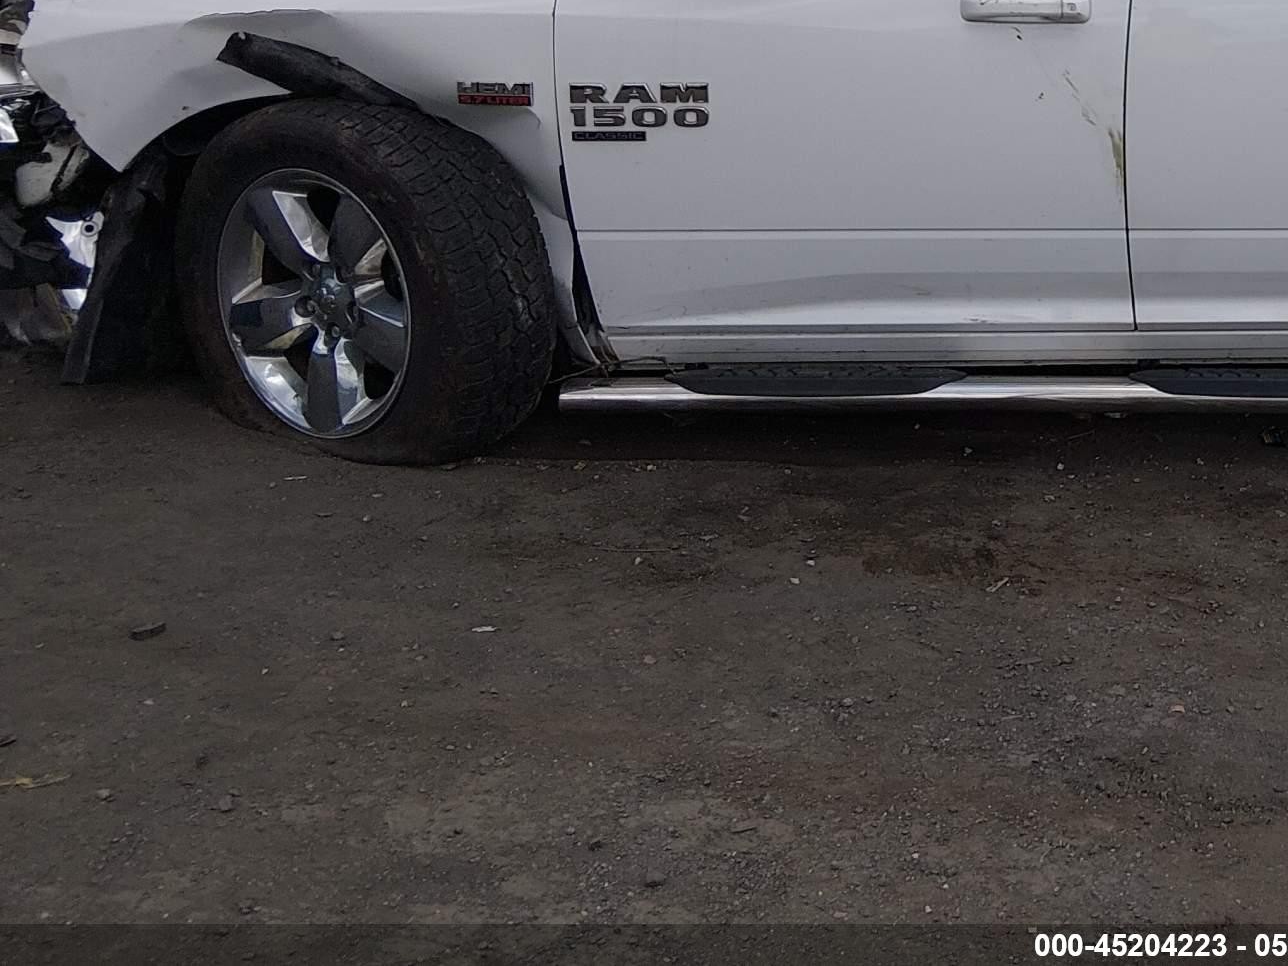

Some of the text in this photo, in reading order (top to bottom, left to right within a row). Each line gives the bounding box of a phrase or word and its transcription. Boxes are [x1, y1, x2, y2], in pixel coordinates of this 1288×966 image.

[457, 82, 533, 94] HEMI
[569, 82, 709, 104] RAM
[570, 106, 709, 128] 1500
[573, 132, 645, 140] CLASSIC
